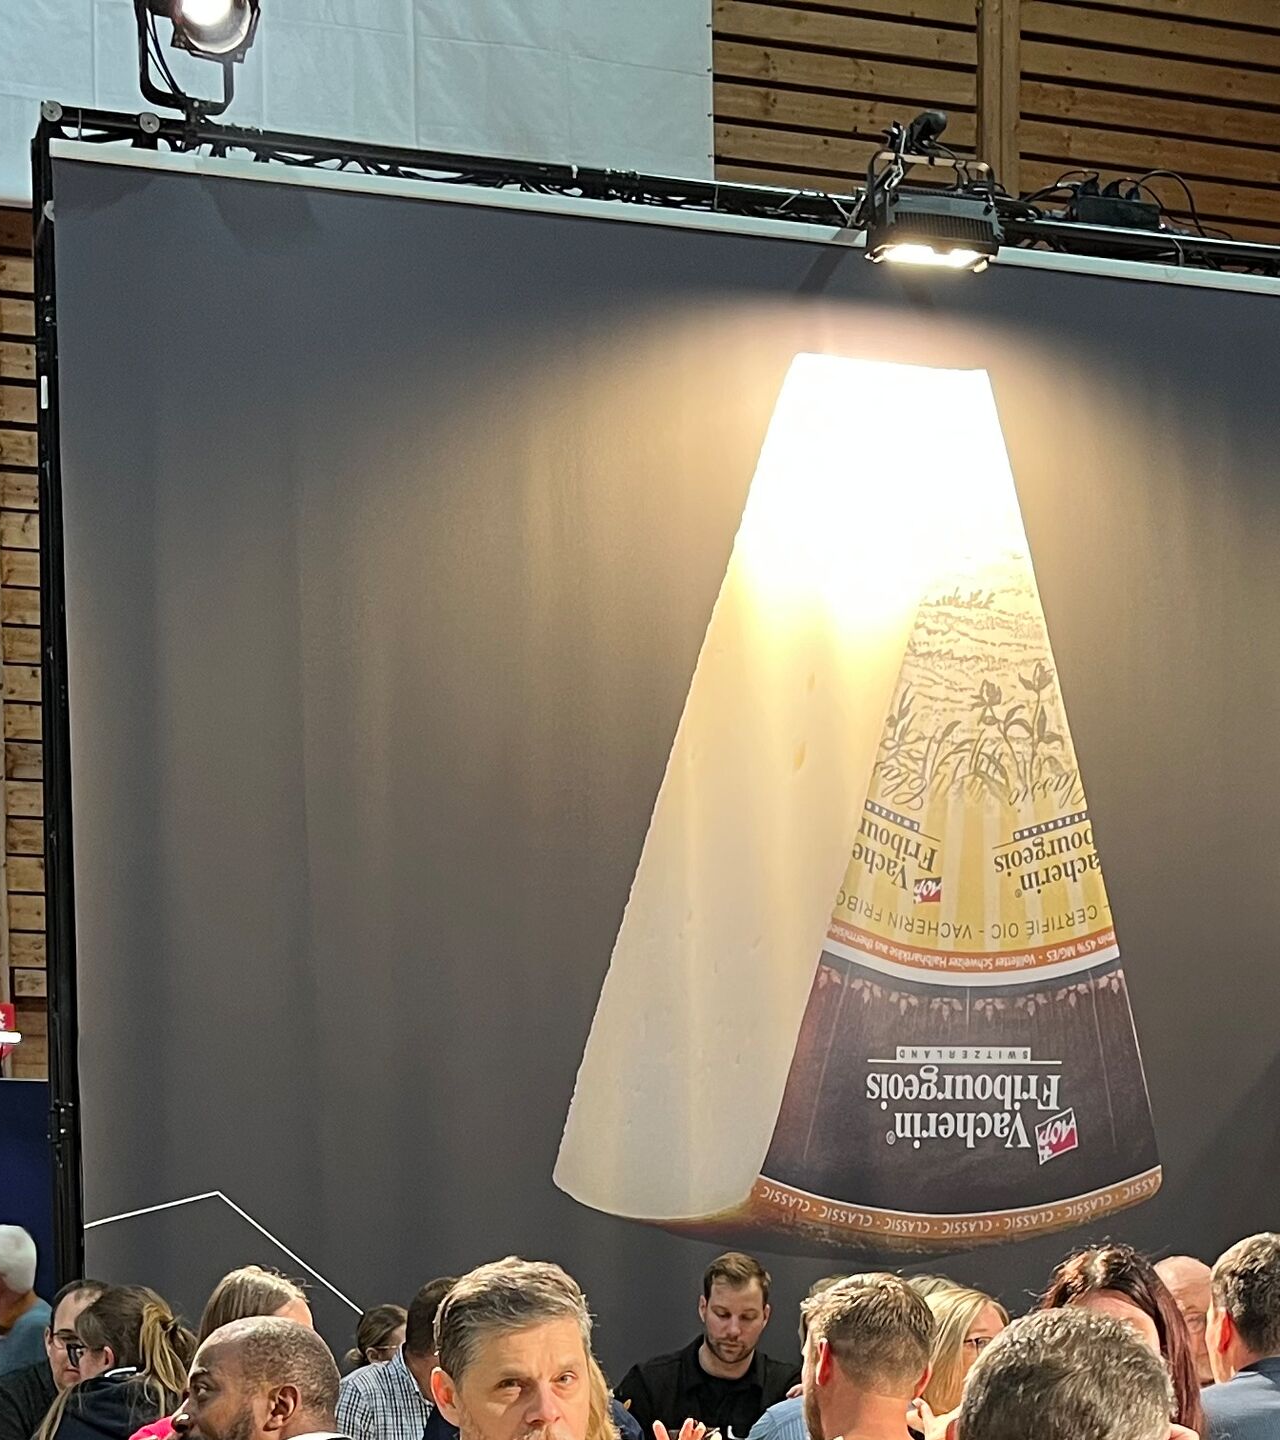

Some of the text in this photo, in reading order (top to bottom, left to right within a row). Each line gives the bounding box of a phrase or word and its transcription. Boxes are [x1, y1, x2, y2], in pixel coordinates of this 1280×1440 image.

[887, 911, 972, 940] VACHERIN
[991, 922, 1020, 939] OIC
[1025, 904, 1098, 940] CERTIFIÉ
[899, 1049, 1029, 1060] SWITZERLAND
[866, 1064, 1062, 1111] Fribourgeois
[759, 1185, 811, 1213] CLASSIC
[1065, 1195, 1113, 1217] CLASSIC
[818, 1204, 873, 1228] CLASSIC
[883, 1217, 931, 1234] CLASSIC
[1004, 1211, 1055, 1231] CLASSIC
[941, 1220, 993, 1235] CLASSIC
